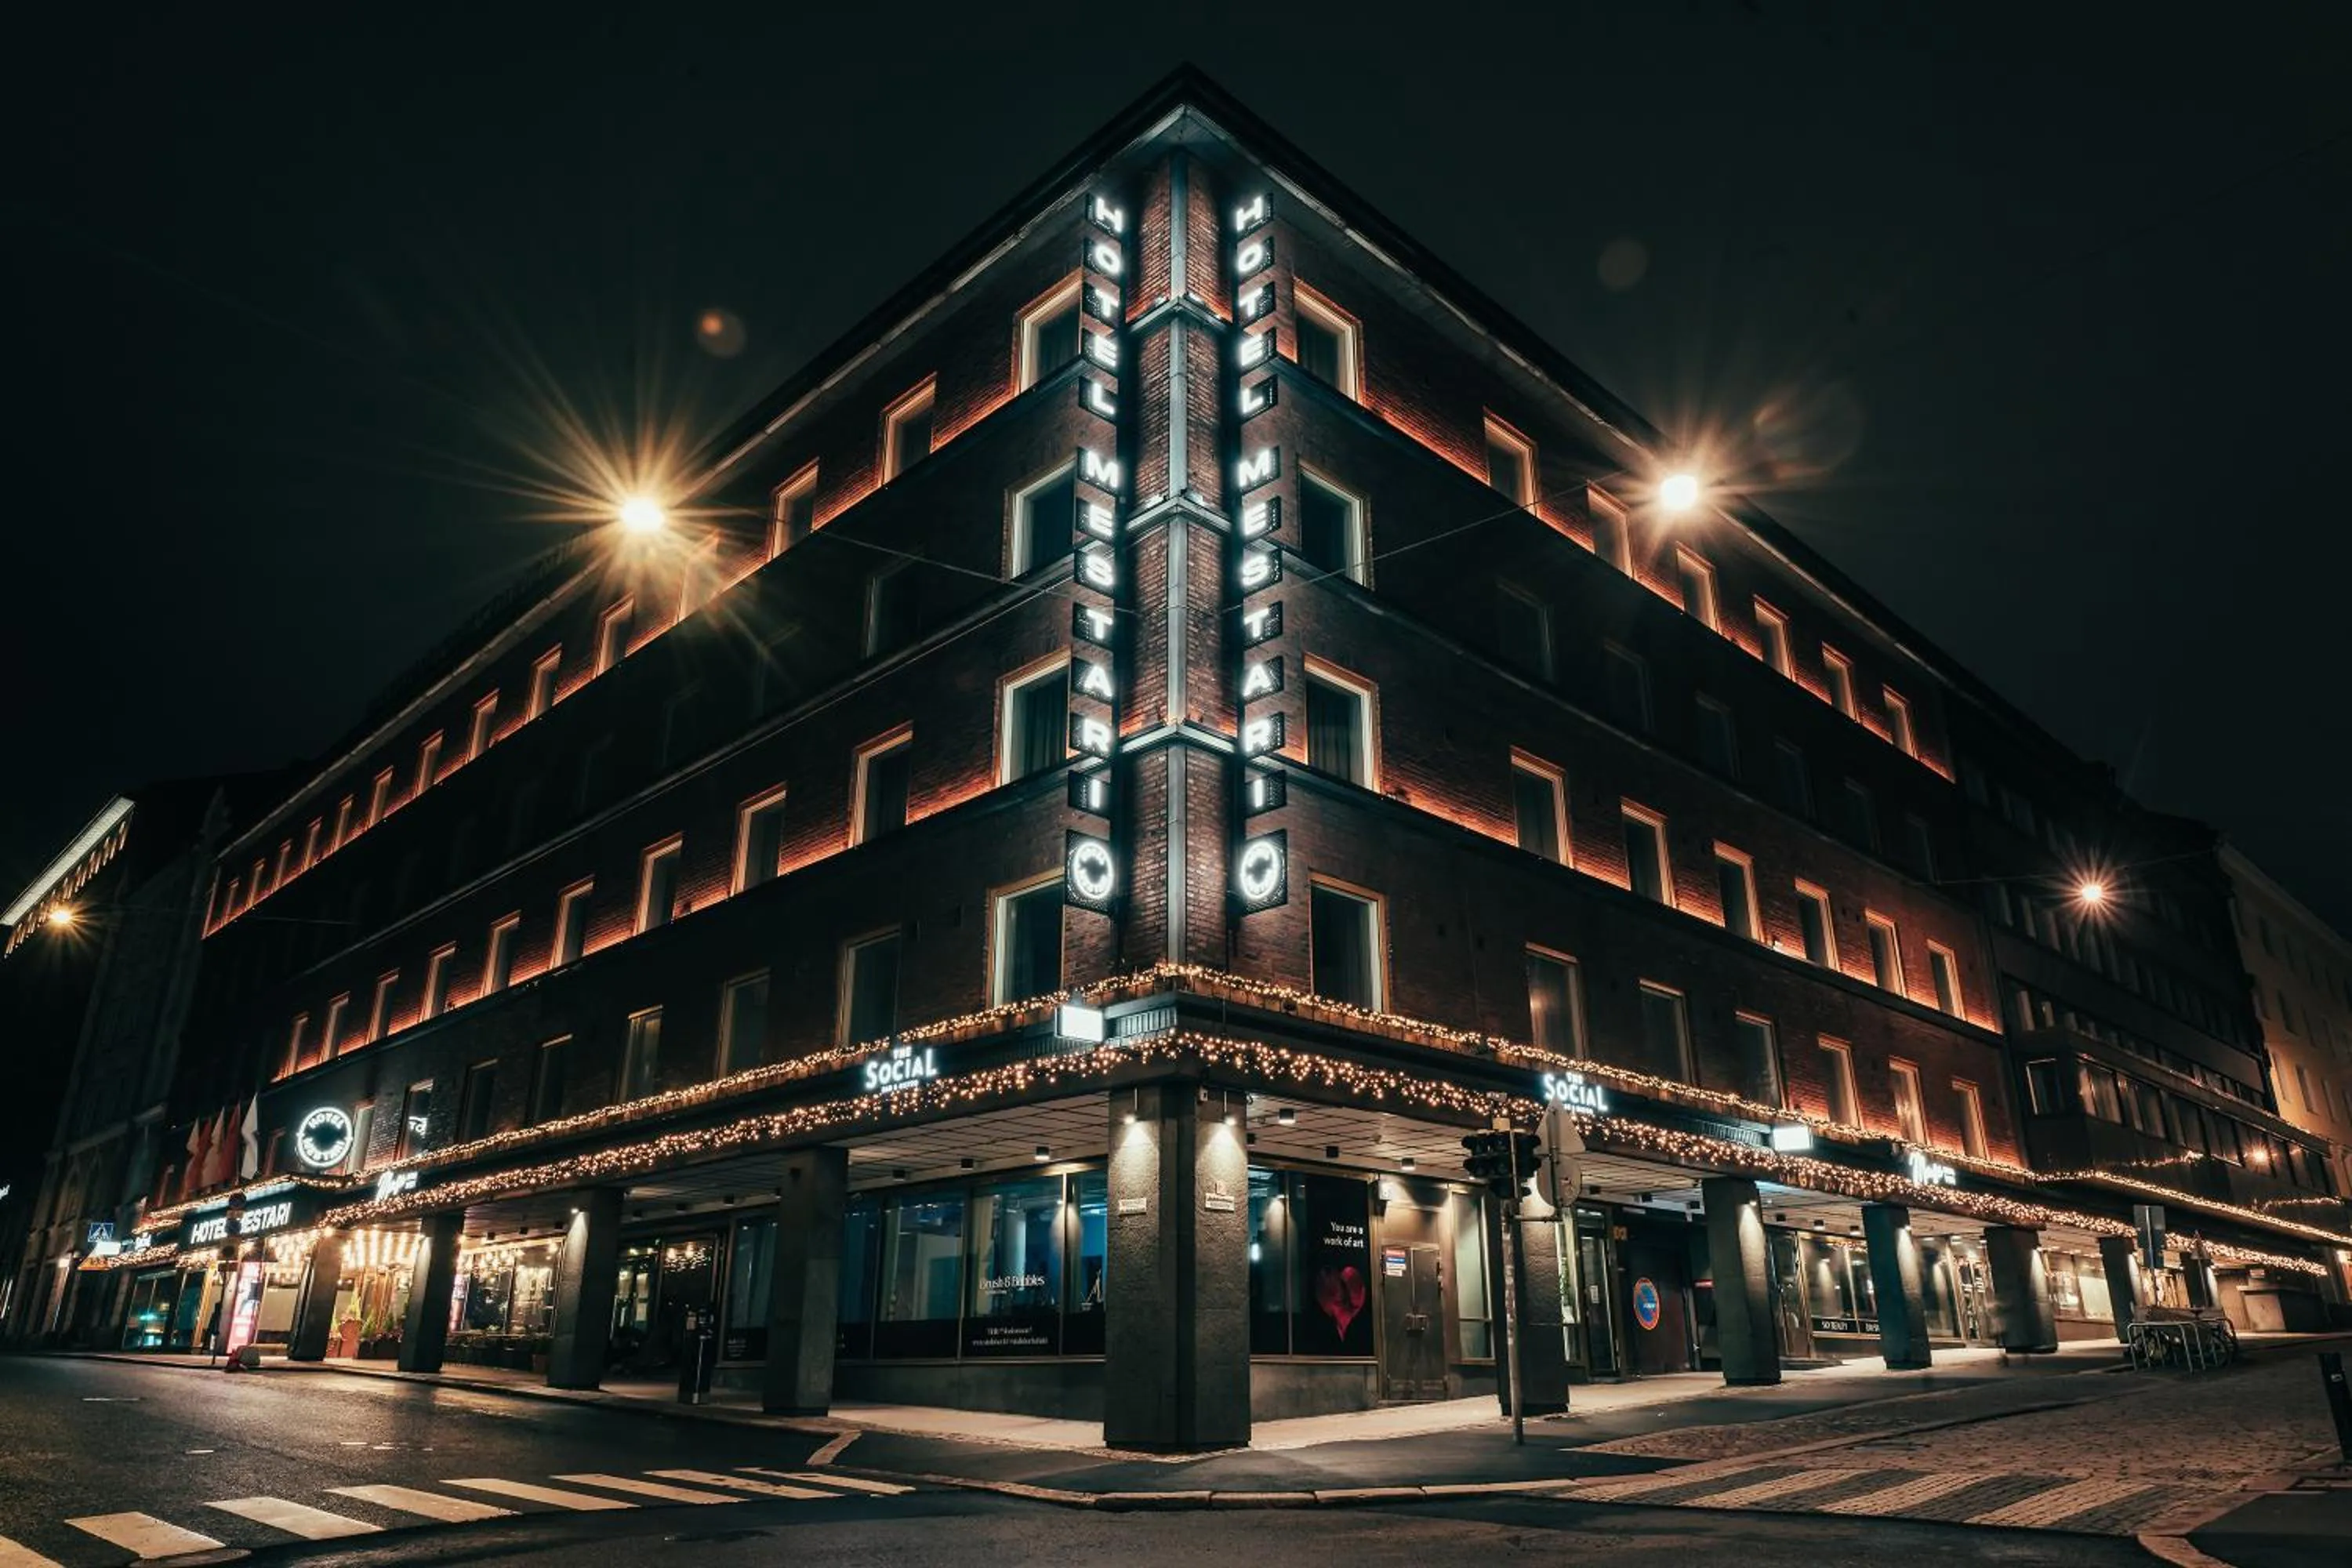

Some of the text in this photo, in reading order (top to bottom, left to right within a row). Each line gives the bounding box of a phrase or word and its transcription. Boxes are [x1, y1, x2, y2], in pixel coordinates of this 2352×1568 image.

[1091, 197, 1123, 416] HOTEL
[1236, 197, 1265, 416] HOTEL
[1082, 448, 1120, 809] MESTARI
[1238, 448, 1272, 809] MESTARI
[866, 1047, 938, 1089] SOCIAL
[1544, 1073, 1609, 1112] SOCIAL
[307, 1112, 345, 1129] HOTEL
[240, 1202, 292, 1234] ESTARI
[1330, 1221, 1345, 1232] You
[1323, 1235, 1363, 1248] work of art
